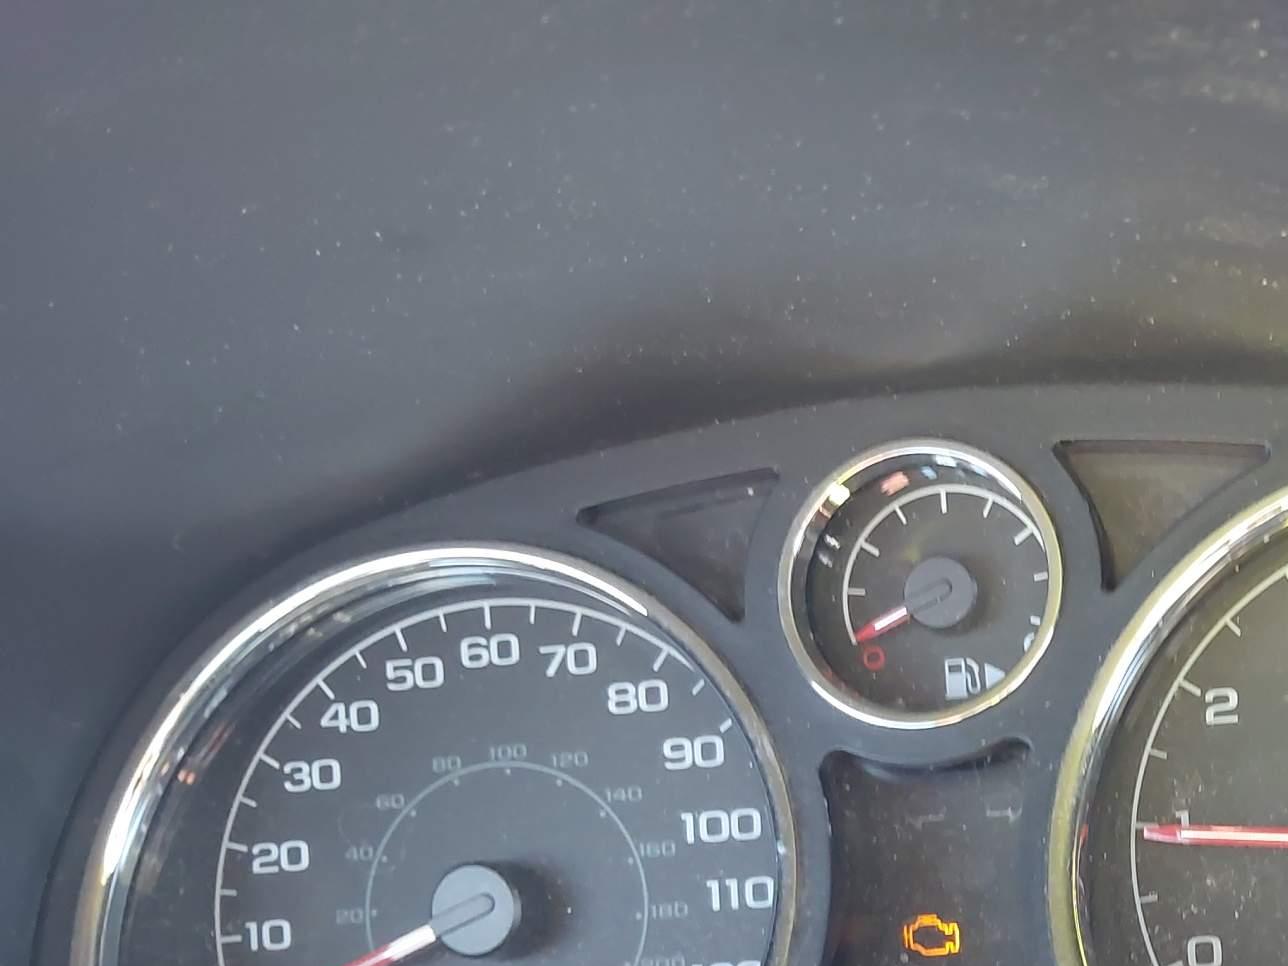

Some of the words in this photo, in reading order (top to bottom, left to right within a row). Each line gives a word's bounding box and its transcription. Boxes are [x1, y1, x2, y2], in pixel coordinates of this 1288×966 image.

[457, 634, 519, 669] 60
[538, 642, 597, 677] 70
[385, 656, 444, 691] 50
[607, 680, 668, 715] 80
[1204, 688, 1239, 725] 2
[319, 700, 379, 735] 40
[488, 744, 528, 761] 100
[550, 751, 589, 769] 120
[662, 735, 724, 770] 90
[283, 759, 341, 794] 30
[604, 785, 643, 802] 140
[681, 808, 762, 844] 100
[251, 841, 310, 874] 20
[344, 846, 374, 863] 40
[706, 877, 774, 912] 110
[245, 920, 292, 951] 10
